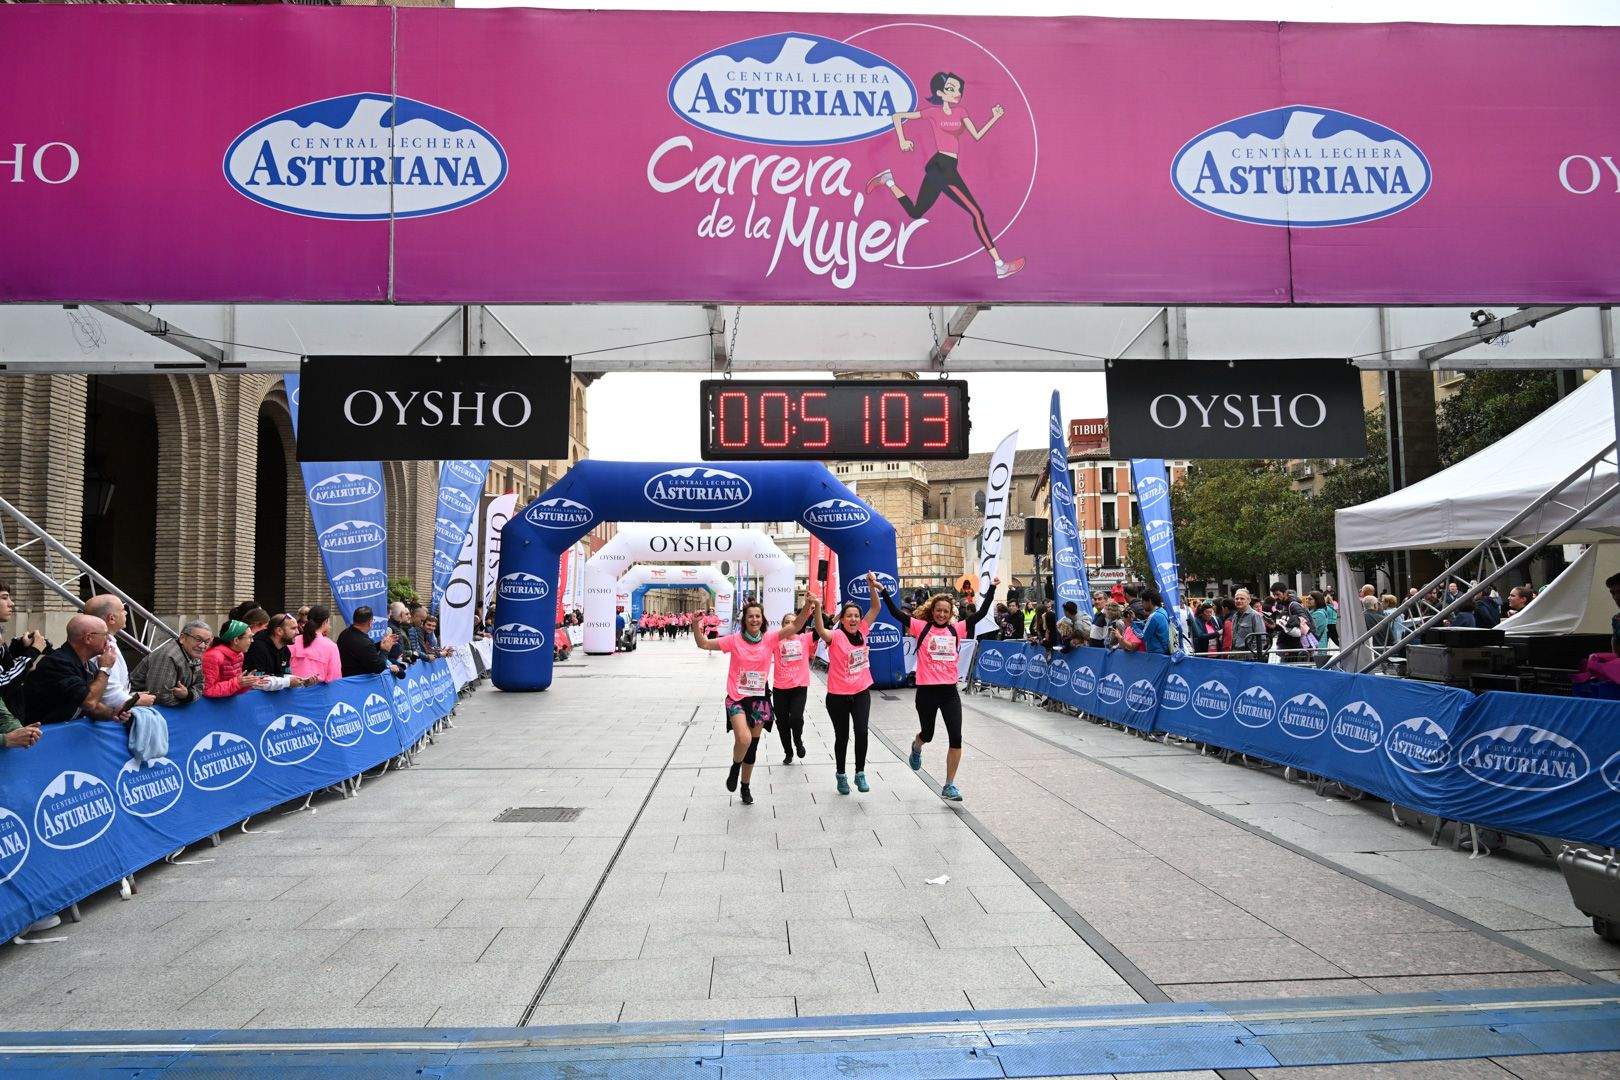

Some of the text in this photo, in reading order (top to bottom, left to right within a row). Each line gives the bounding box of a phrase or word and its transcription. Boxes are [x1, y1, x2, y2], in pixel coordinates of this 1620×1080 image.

[727, 71, 890, 84] CENTRAL LECHERA
[688, 73, 897, 117] ASTURIANA
[291, 137, 477, 149] CENTRAL LECHERA
[1232, 147, 1403, 159] CENTRAL LECHERA
[245, 139, 486, 187] ASTURIANA
[646, 135, 852, 196] Carrera
[1192, 150, 1413, 195] ASTURIANA
[697, 191, 930, 289] de la Mujer
[343, 389, 532, 428] OYSHO
[1149, 393, 1327, 429] OYSHO
[1072, 424, 1104, 436] TIBUR
[652, 480, 744, 500] ASTURIANA
[529, 508, 588, 522] ASTURIANA
[808, 511, 866, 523] ASTURIANA
[649, 535, 732, 552] OYSHO
[979, 462, 1008, 599] OYSHO
[1280, 706, 1325, 731] ASTURIANA
[266, 731, 319, 758] ASTURIANA
[193, 751, 254, 782] ASTURIANA
[1465, 744, 1578, 779] ASTURIANA
[51, 787, 105, 811] CENTRAL LECHERA
[123, 775, 180, 806] ASTURIANA
[0, 820, 15, 832] ERA
[43, 796, 113, 840] ASTURIANA
